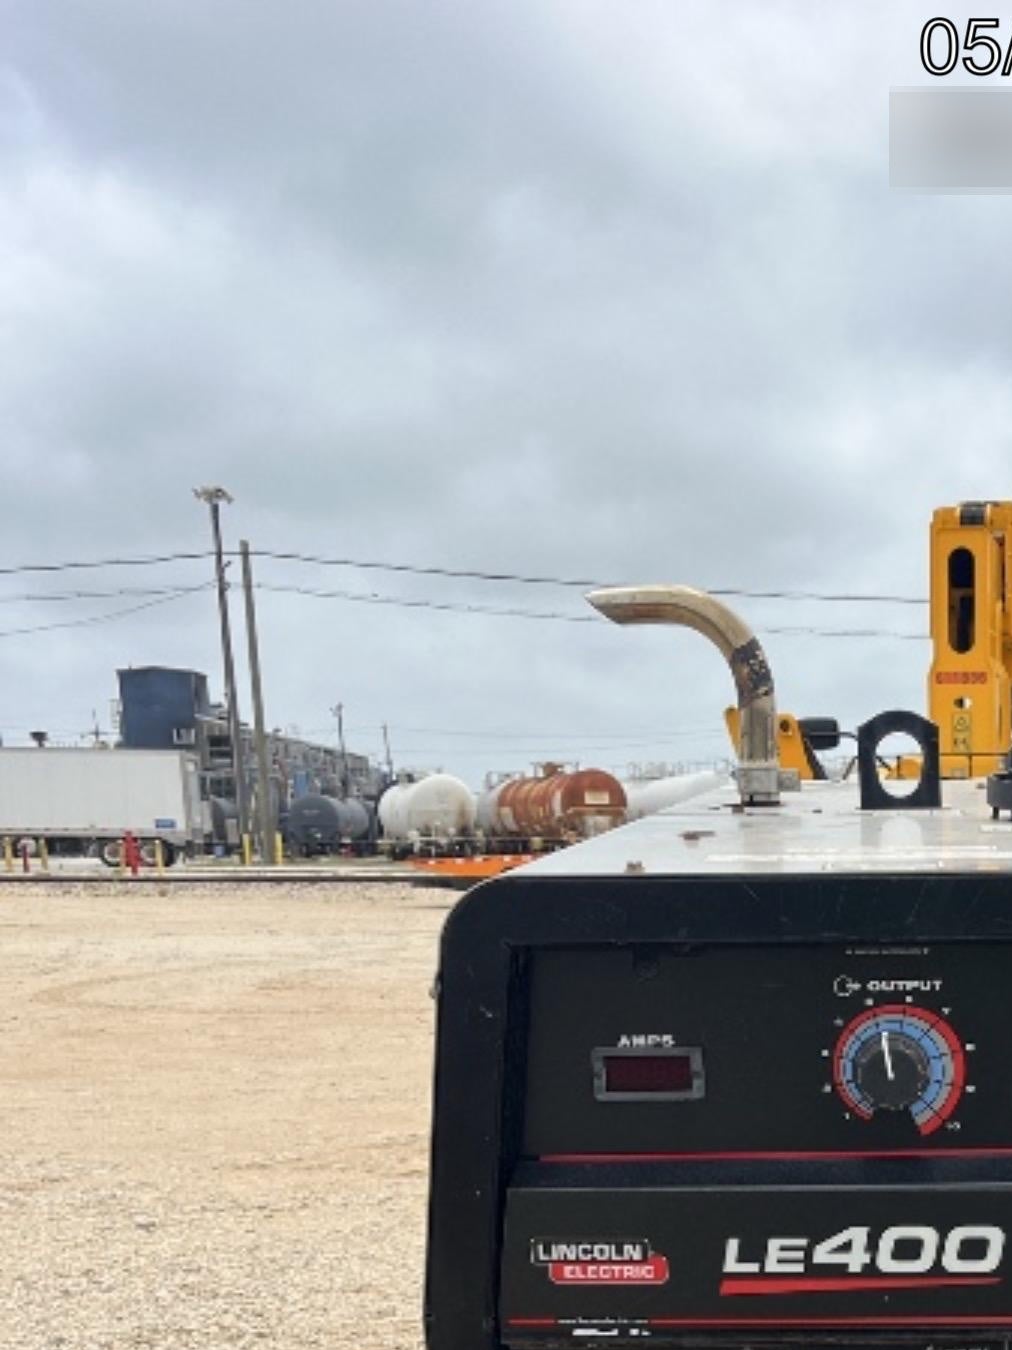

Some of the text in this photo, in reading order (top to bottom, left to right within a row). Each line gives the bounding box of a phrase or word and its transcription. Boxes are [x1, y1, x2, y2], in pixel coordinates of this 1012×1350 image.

[866, 980, 942, 991] OUTPUT
[617, 1034, 675, 1047] AMPS
[538, 1244, 643, 1261] LINCOLN
[722, 1225, 1006, 1273] LE400
[563, 1265, 655, 1279] ELECTRIC
